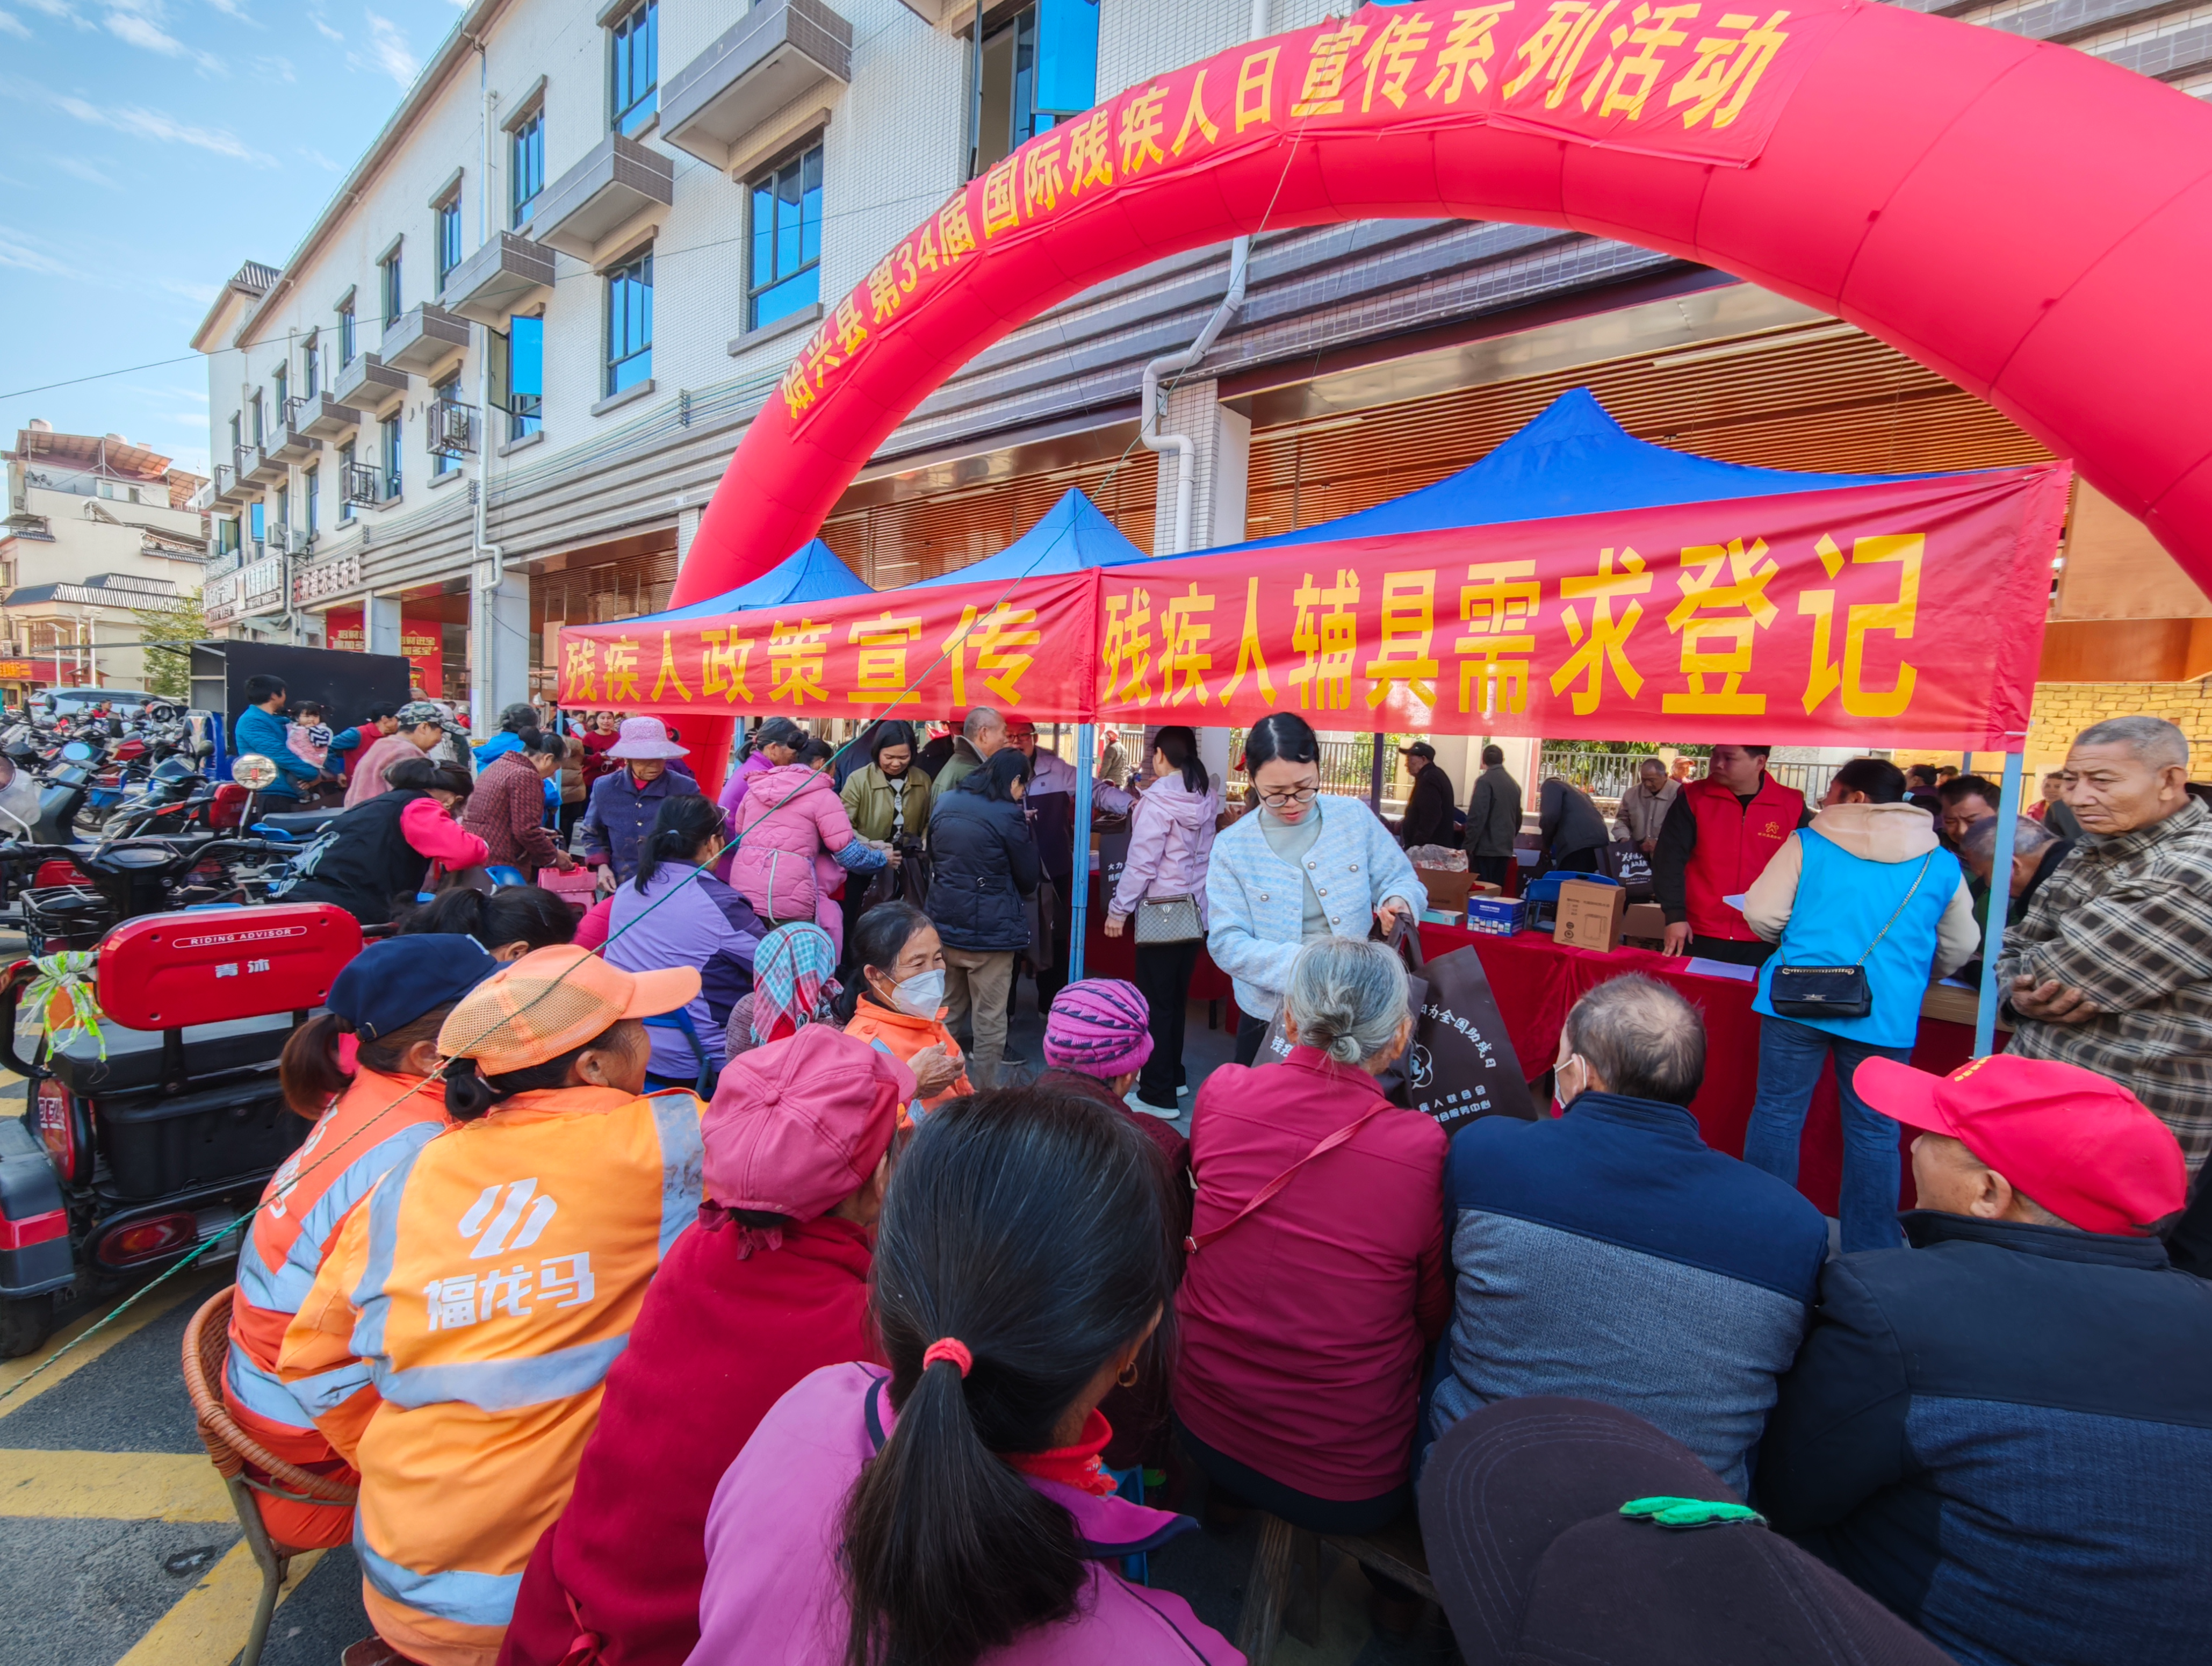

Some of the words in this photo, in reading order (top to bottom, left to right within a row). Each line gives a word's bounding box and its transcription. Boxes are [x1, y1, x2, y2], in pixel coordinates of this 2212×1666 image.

[565, 602, 1041, 707] 残疾人政策宣传
[1102, 533, 1926, 717] 残疾人辅具需求登记
[191, 935, 235, 945] RIDING
[240, 929, 291, 939] ADVISOR
[423, 1251, 595, 1331] 福龙马
